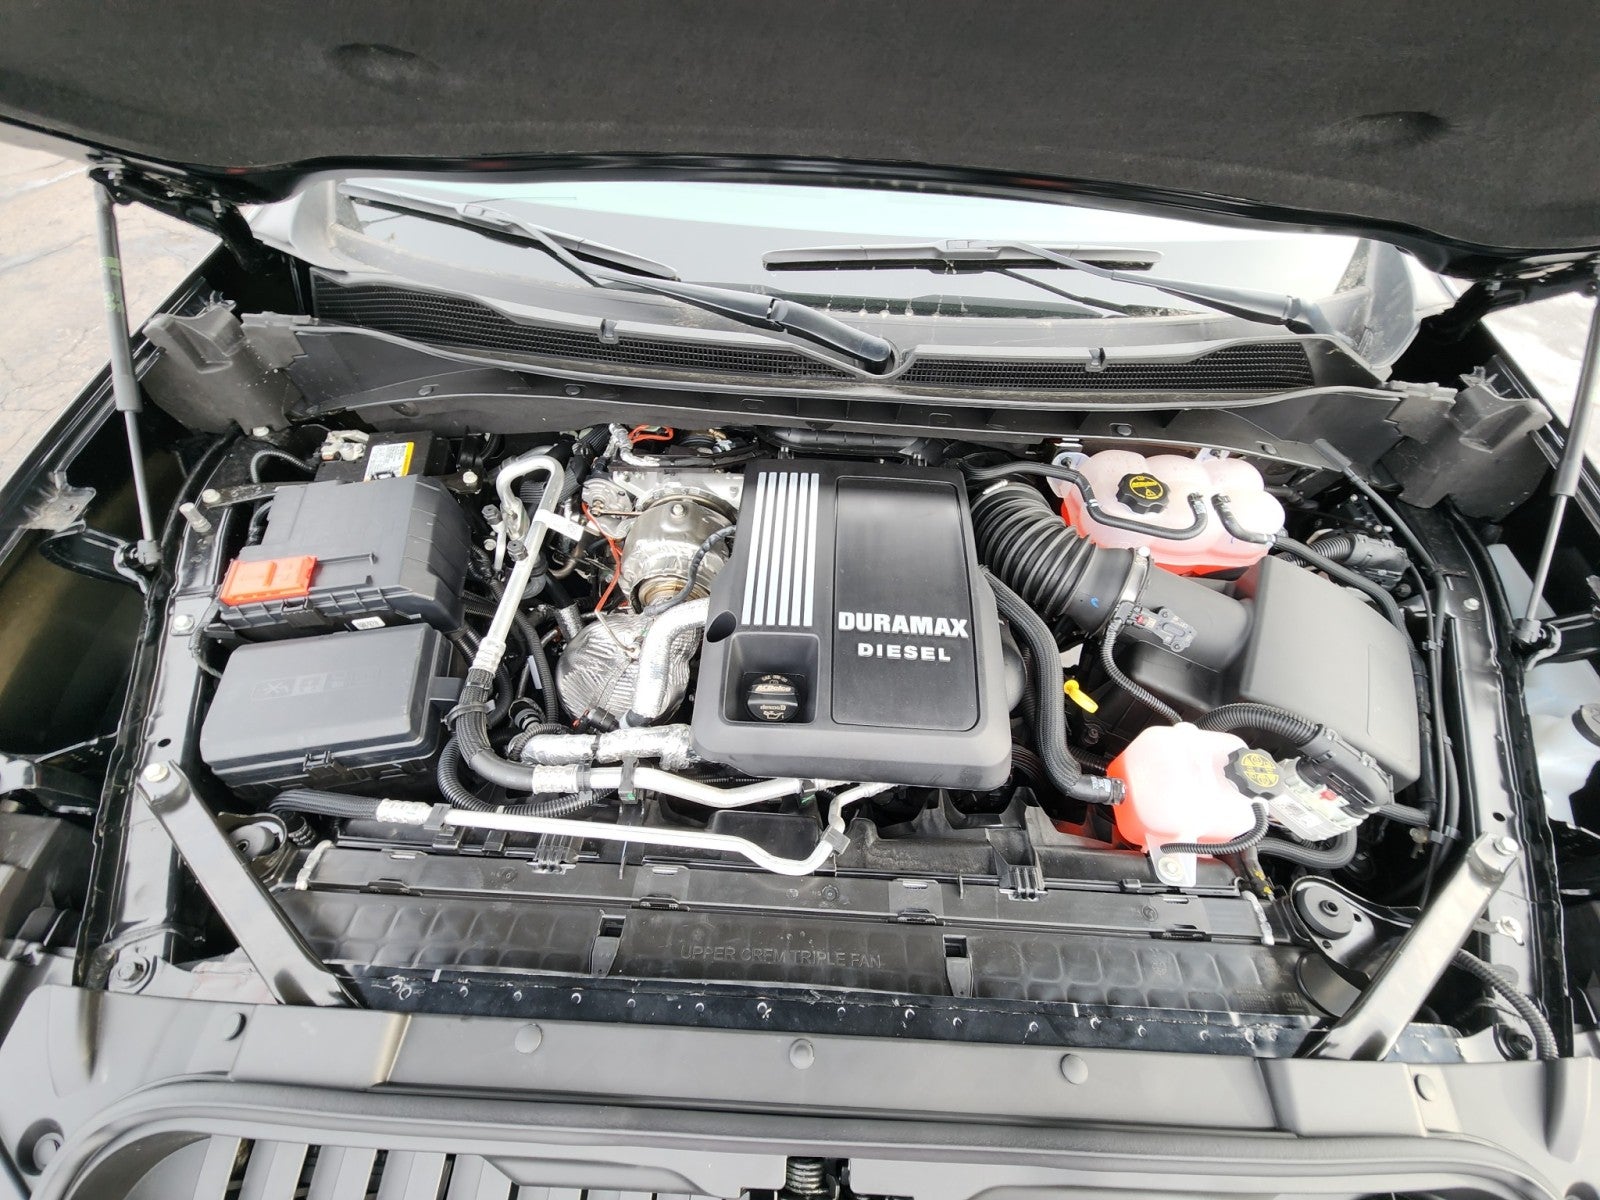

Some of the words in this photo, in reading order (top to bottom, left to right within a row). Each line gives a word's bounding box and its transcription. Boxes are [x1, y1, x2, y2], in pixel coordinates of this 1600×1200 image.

[838, 611, 969, 639] DURAMAX
[857, 642, 951, 662] DIESEL
[680, 944, 736, 962] UPPER
[789, 949, 846, 967] TRIPLE
[850, 952, 881, 969] FAN
